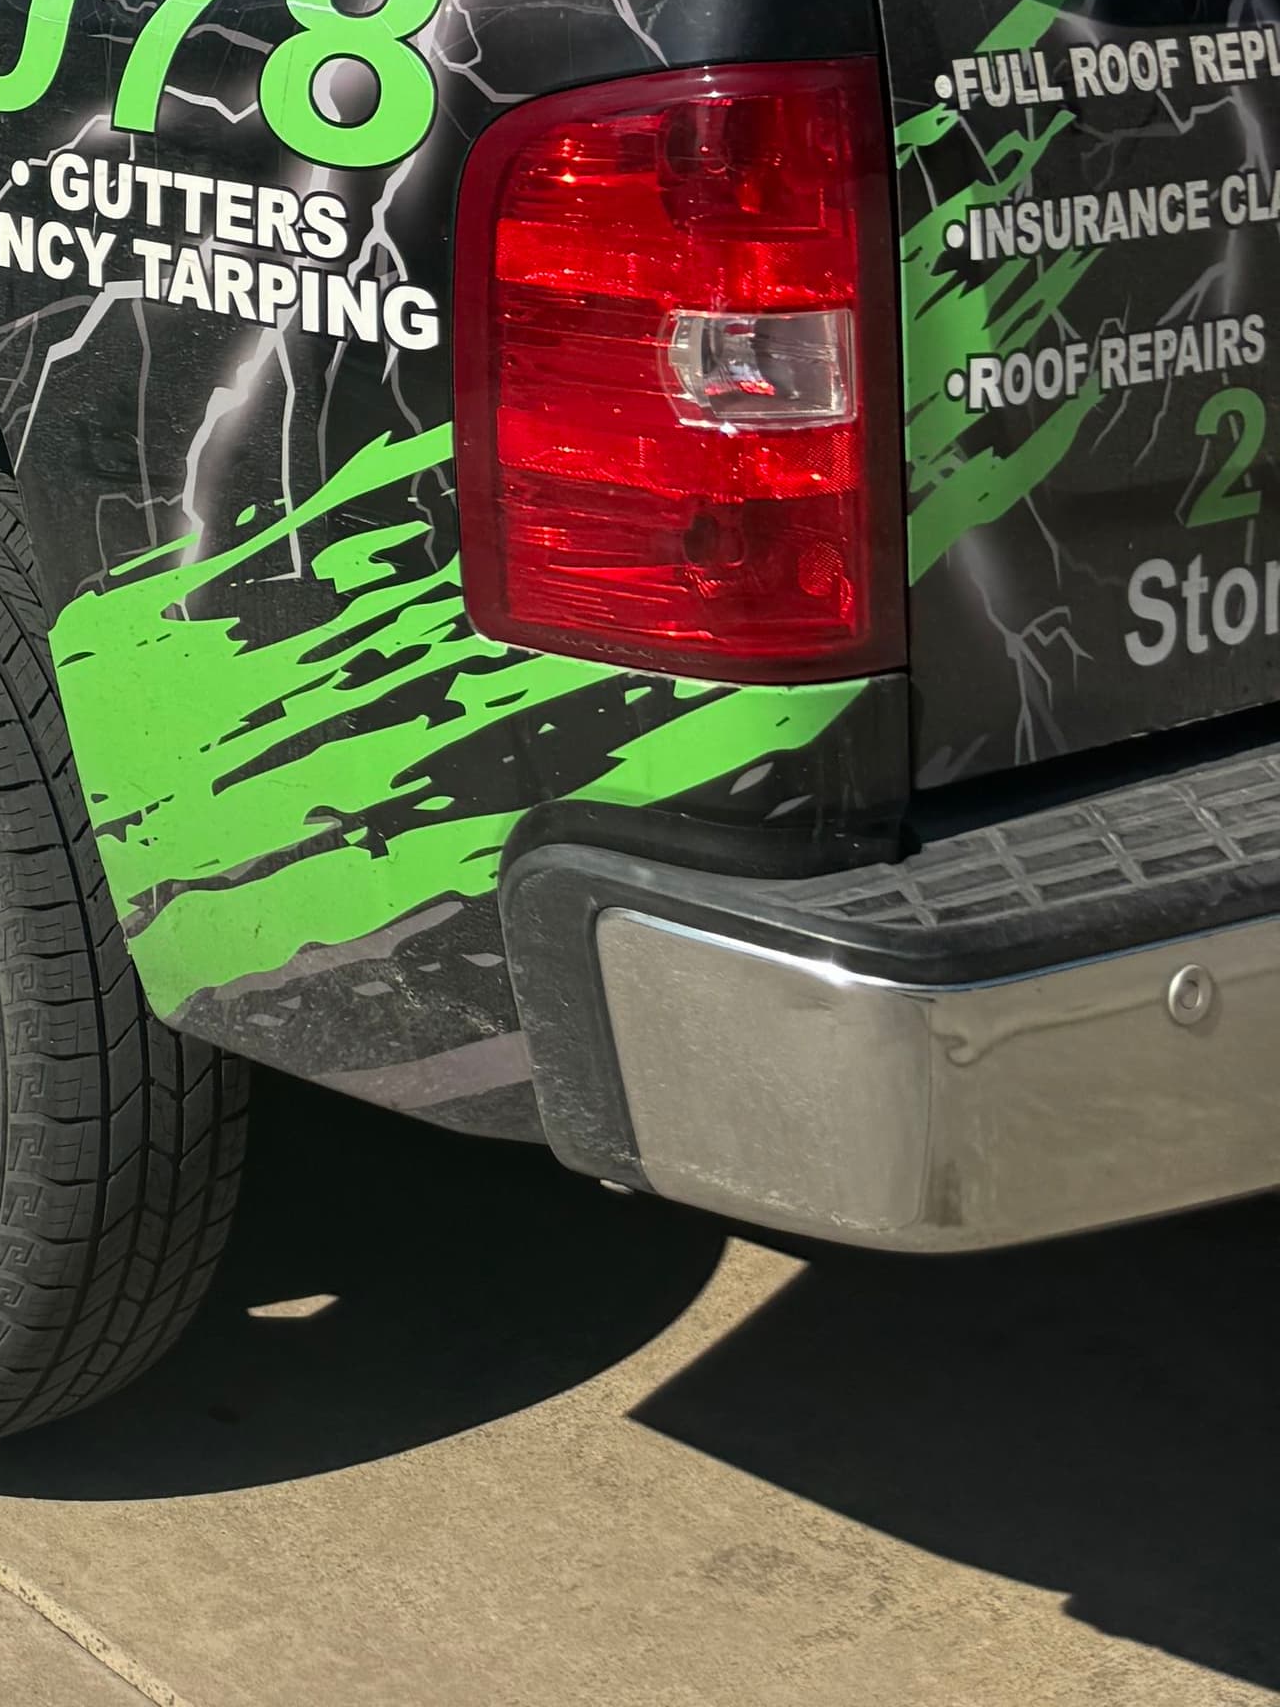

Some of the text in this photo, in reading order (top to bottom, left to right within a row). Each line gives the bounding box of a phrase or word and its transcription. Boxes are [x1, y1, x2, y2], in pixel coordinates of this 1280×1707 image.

[952, 51, 1064, 111] FULL
[1068, 38, 1179, 98] ROOF
[49, 154, 348, 259] GUTTERS
[970, 179, 1210, 261] INSURANCE
[132, 241, 439, 351] TARPING
[969, 314, 1265, 410] ROOF REPAIRS
[1195, 387, 1266, 529] 2
